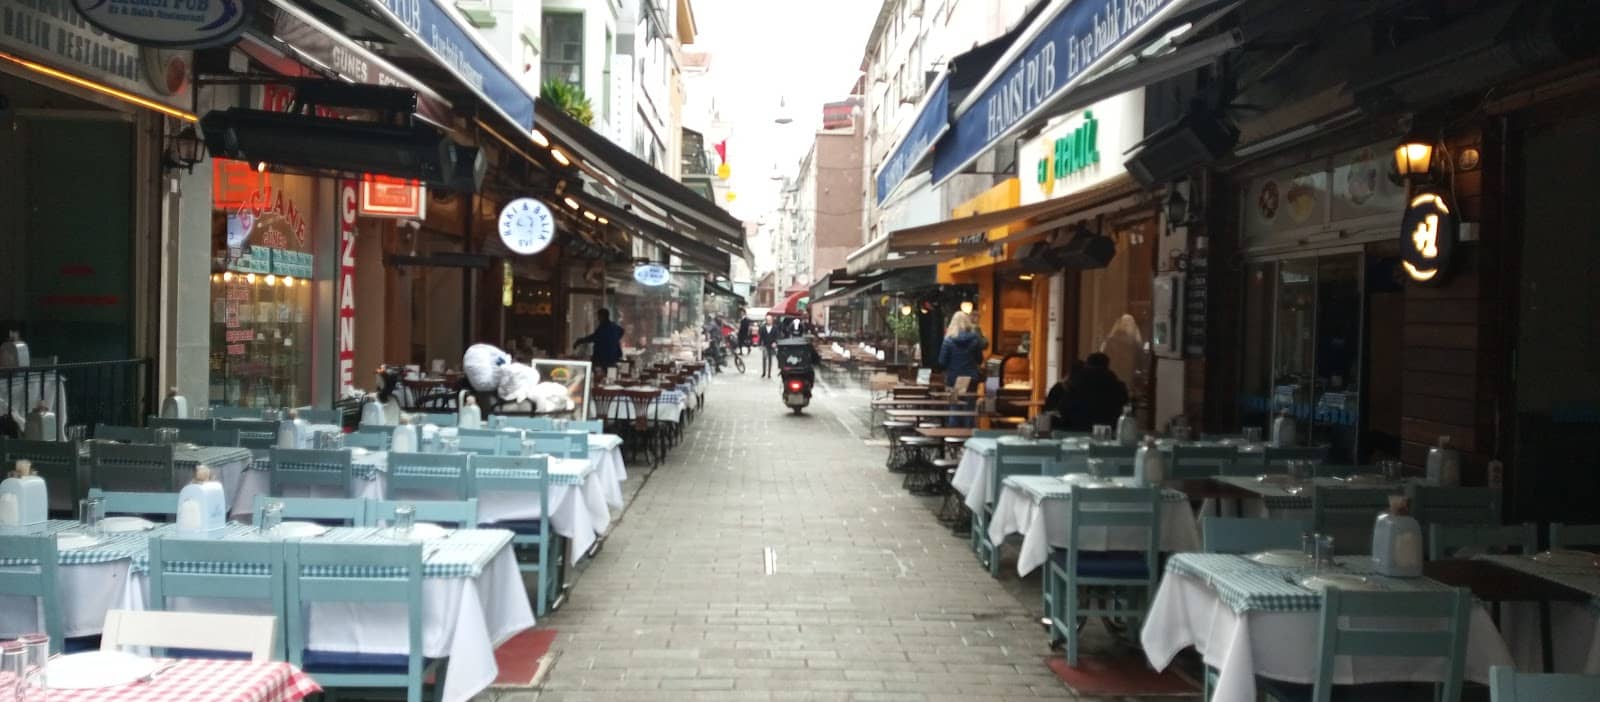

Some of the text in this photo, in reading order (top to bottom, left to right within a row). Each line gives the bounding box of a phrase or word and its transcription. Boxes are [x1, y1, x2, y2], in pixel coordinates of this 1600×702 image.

[987, 57, 1025, 142] HAMSİ
[1026, 39, 1056, 112] PUB
[1067, 34, 1079, 79] Et
